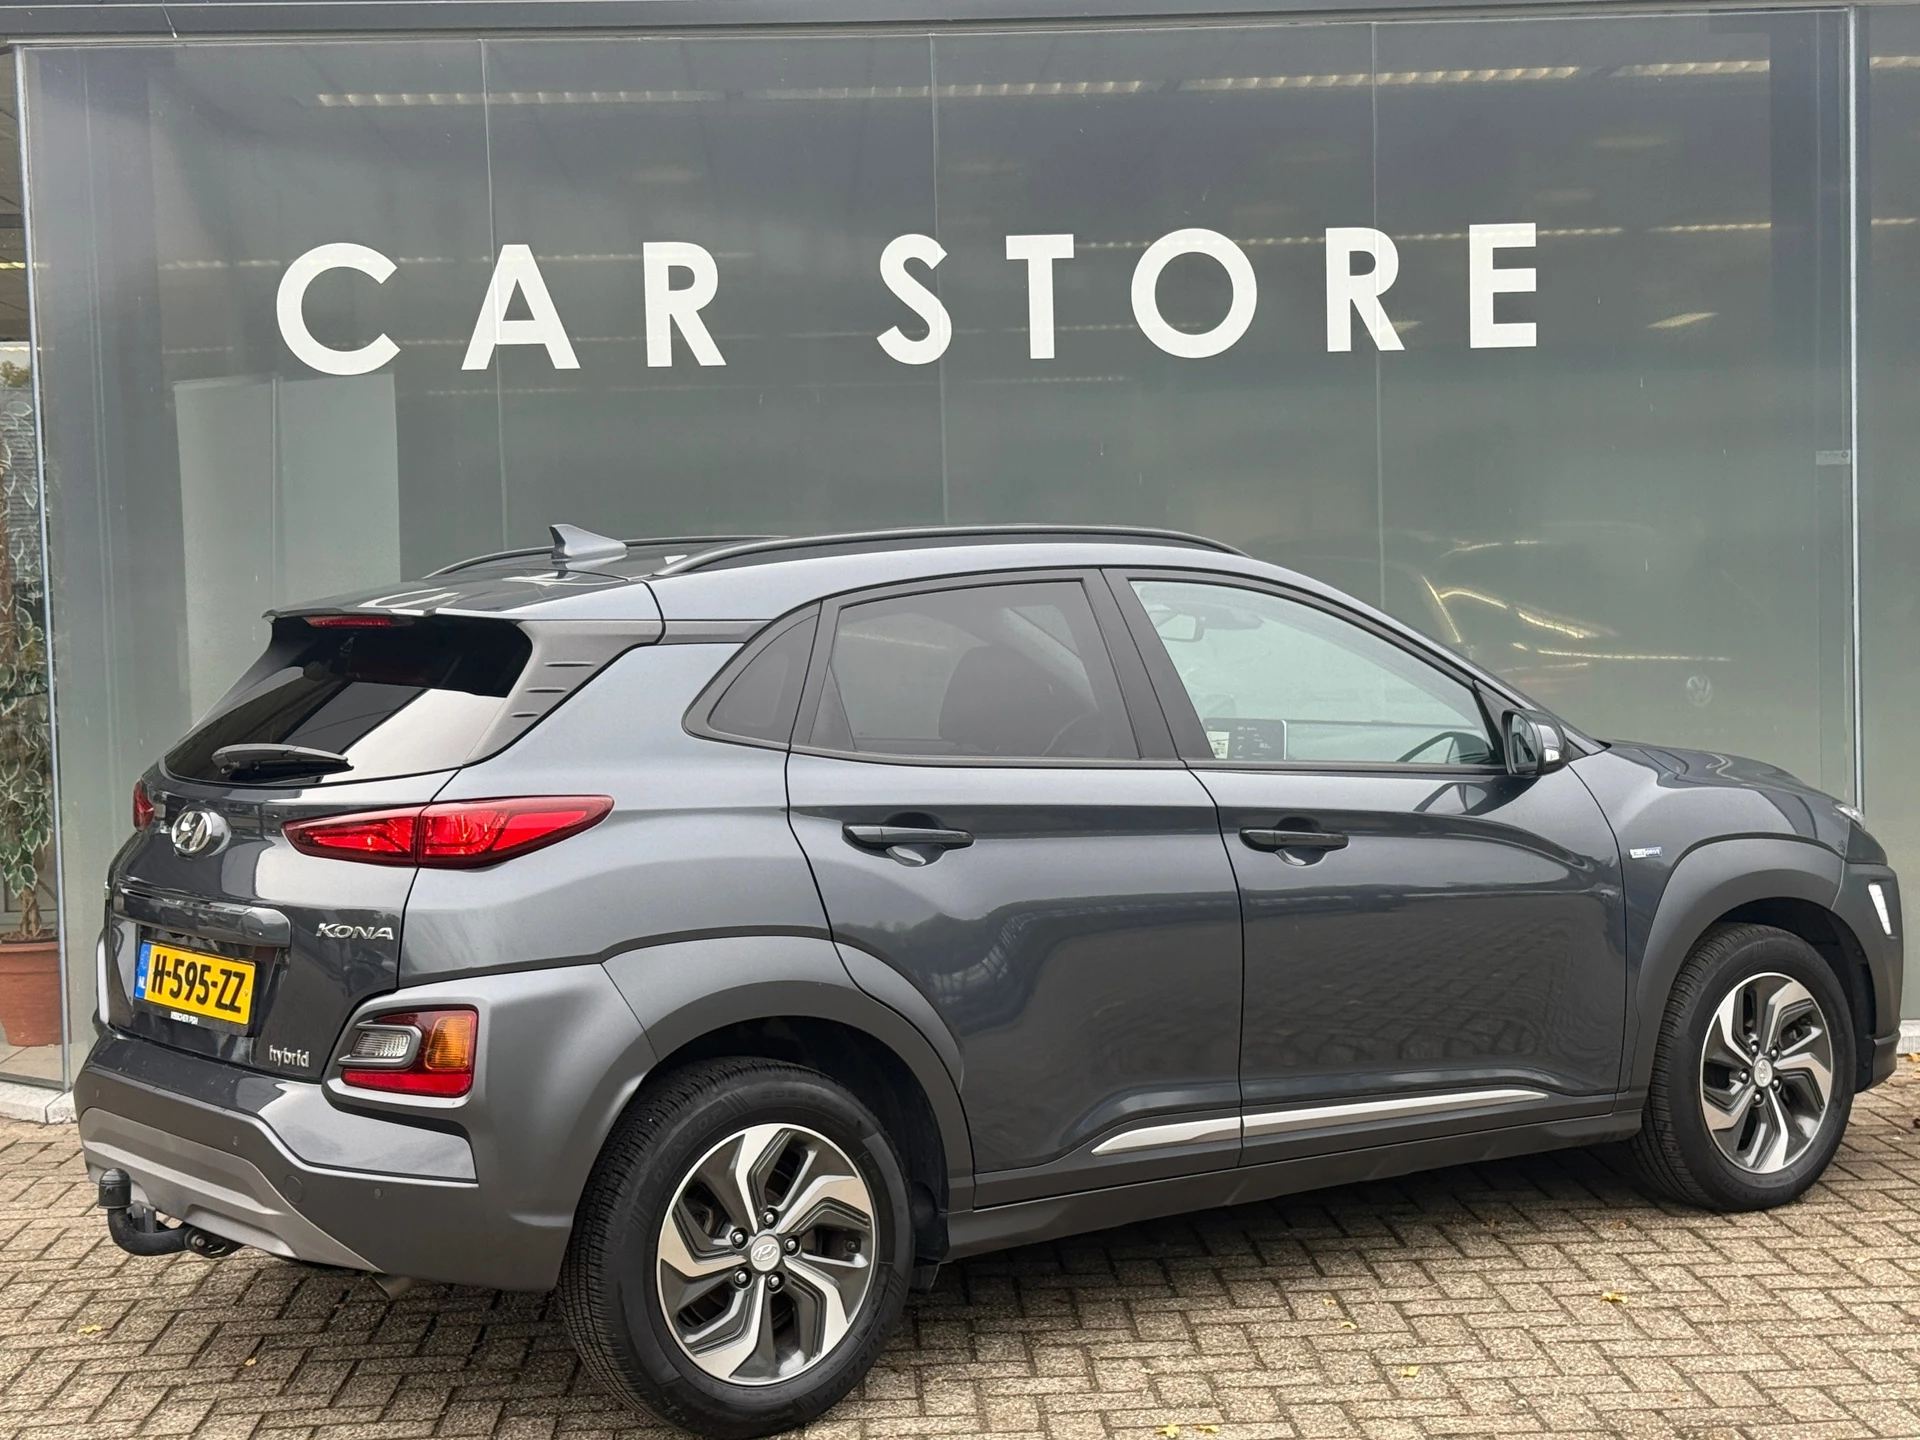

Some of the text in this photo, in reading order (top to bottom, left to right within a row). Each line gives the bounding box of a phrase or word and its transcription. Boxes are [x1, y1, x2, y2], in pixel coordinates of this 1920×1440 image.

[276, 222, 1537, 376] CAR STORE
[315, 922, 394, 941] KONA
[137, 975, 146, 989] NL
[151, 953, 246, 1014] H-595-ZZ
[269, 1044, 310, 1068] hybrid
